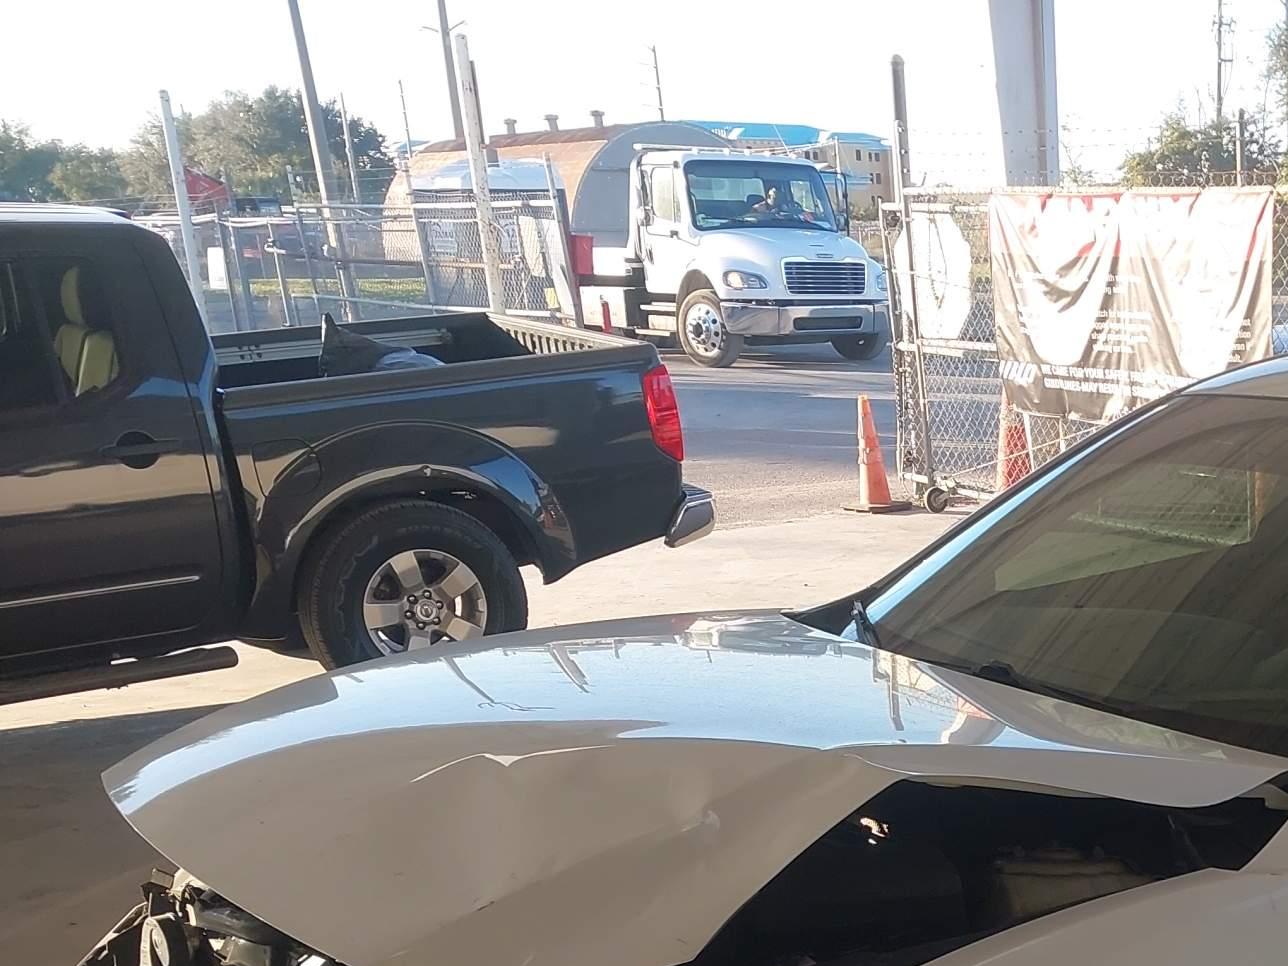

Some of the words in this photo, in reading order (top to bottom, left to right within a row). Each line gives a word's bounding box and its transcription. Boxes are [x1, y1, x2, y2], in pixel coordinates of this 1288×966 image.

[1052, 365, 1069, 376] CARE
[1070, 366, 1084, 378] FOR
[1084, 367, 1104, 379] YOUR
